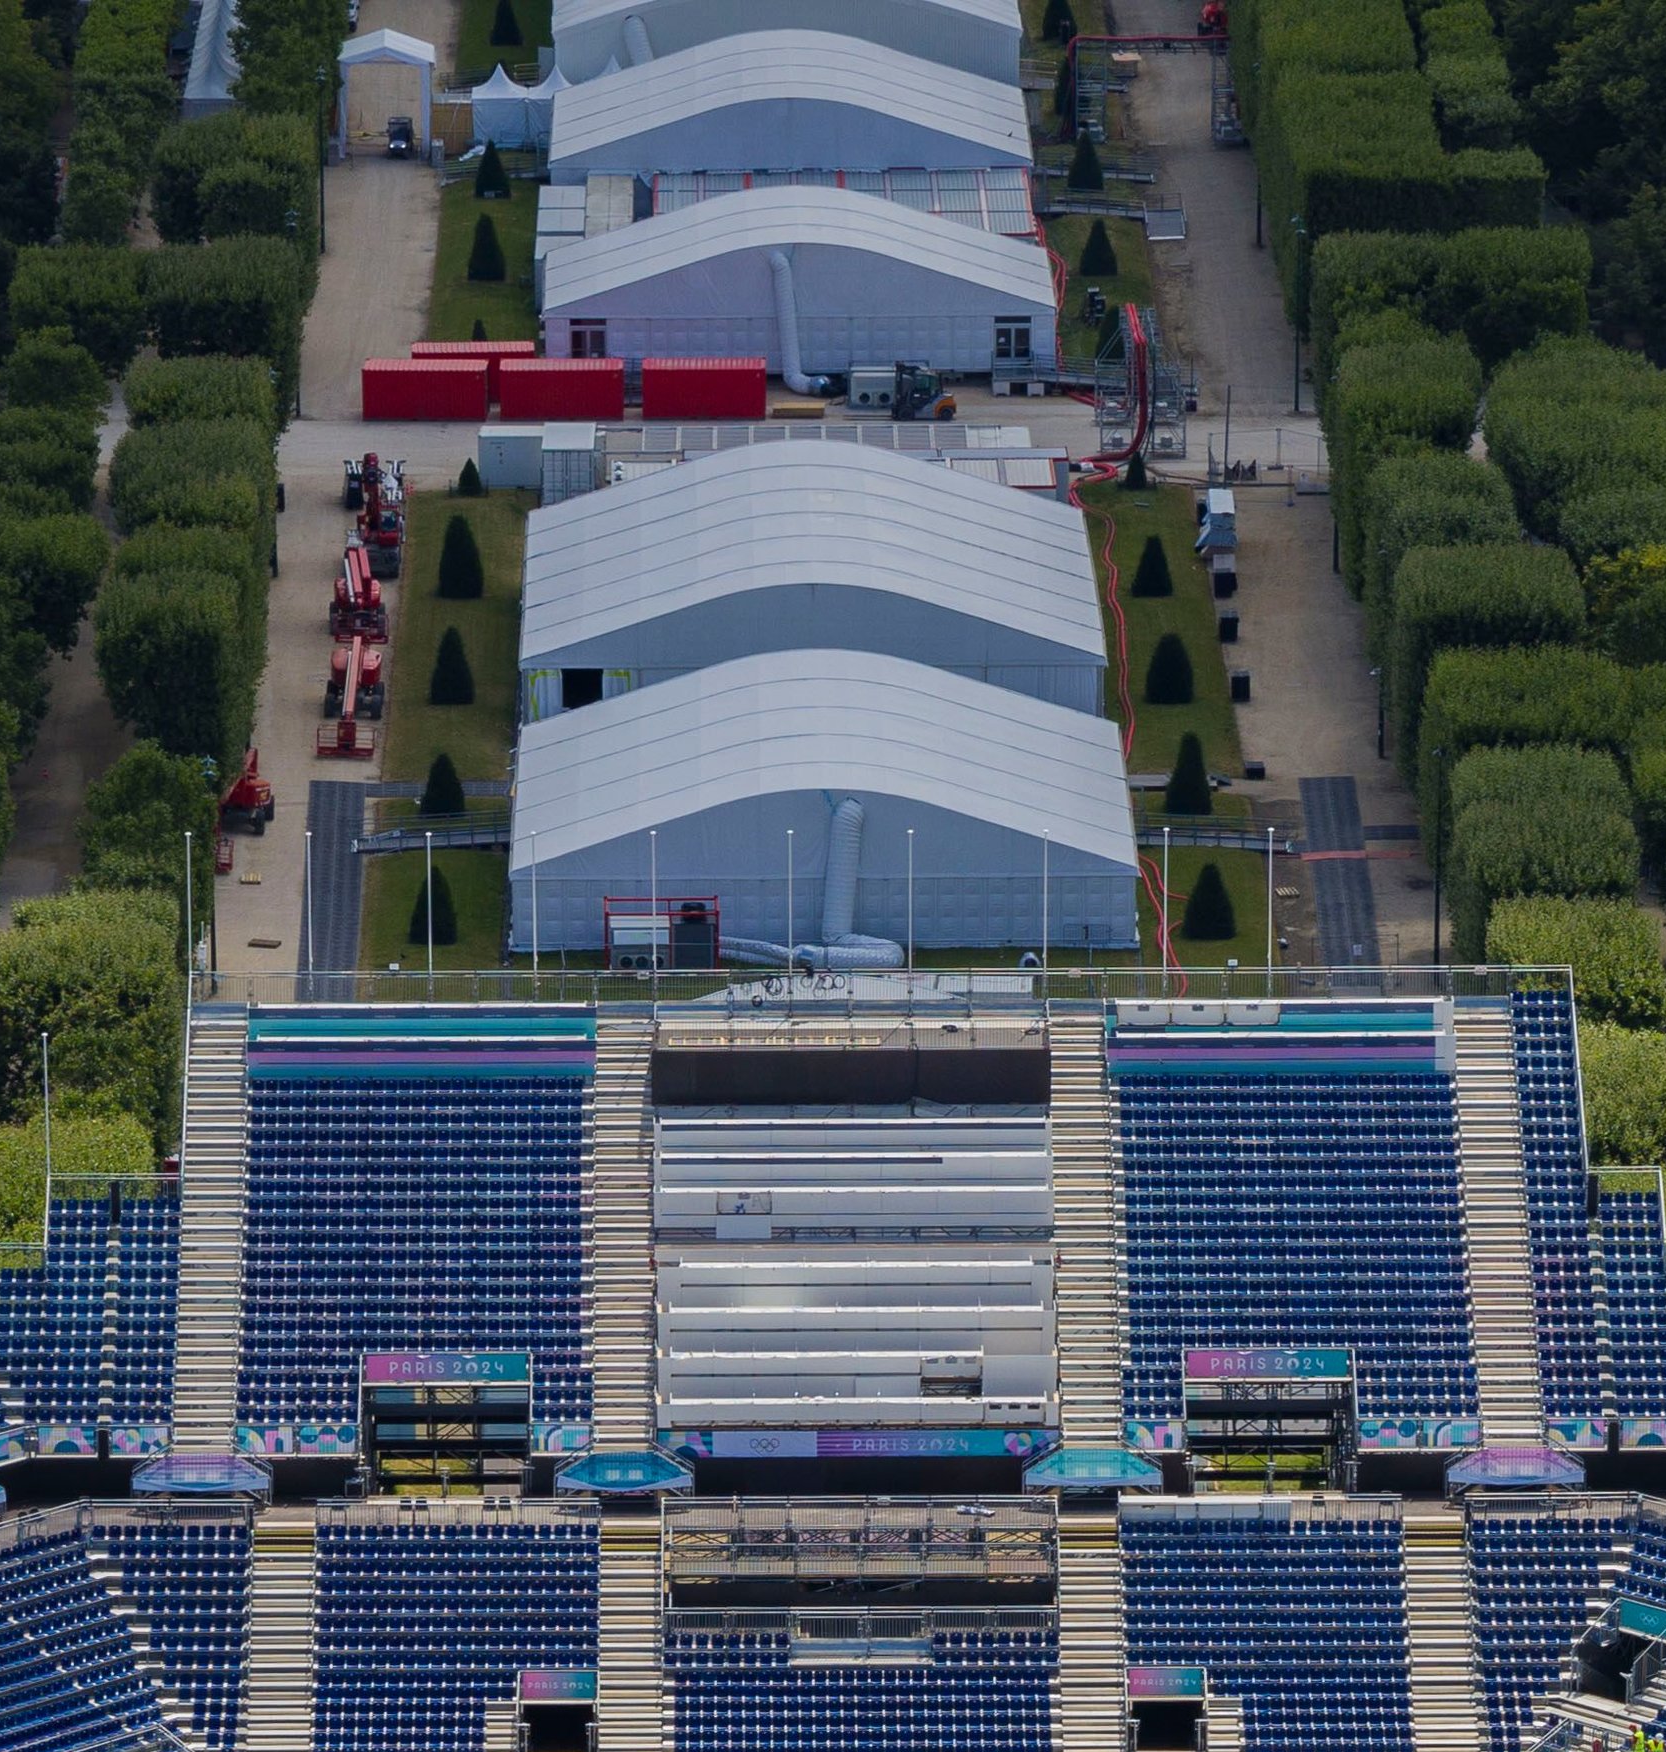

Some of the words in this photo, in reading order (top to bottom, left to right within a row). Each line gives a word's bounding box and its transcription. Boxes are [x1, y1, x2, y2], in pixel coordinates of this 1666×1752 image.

[389, 1361, 445, 1374] PARIS
[453, 1361, 504, 1374] 2024
[1210, 1357, 1266, 1370] PARIS
[1274, 1357, 1324, 1370] 2024
[852, 1438, 910, 1451] PARIS
[917, 1438, 969, 1451] 2024
[527, 1681, 559, 1690] PARIS
[562, 1681, 590, 1690] 2024
[1133, 1678, 1165, 1687] PARIS
[1168, 1678, 1197, 1687] 2024
